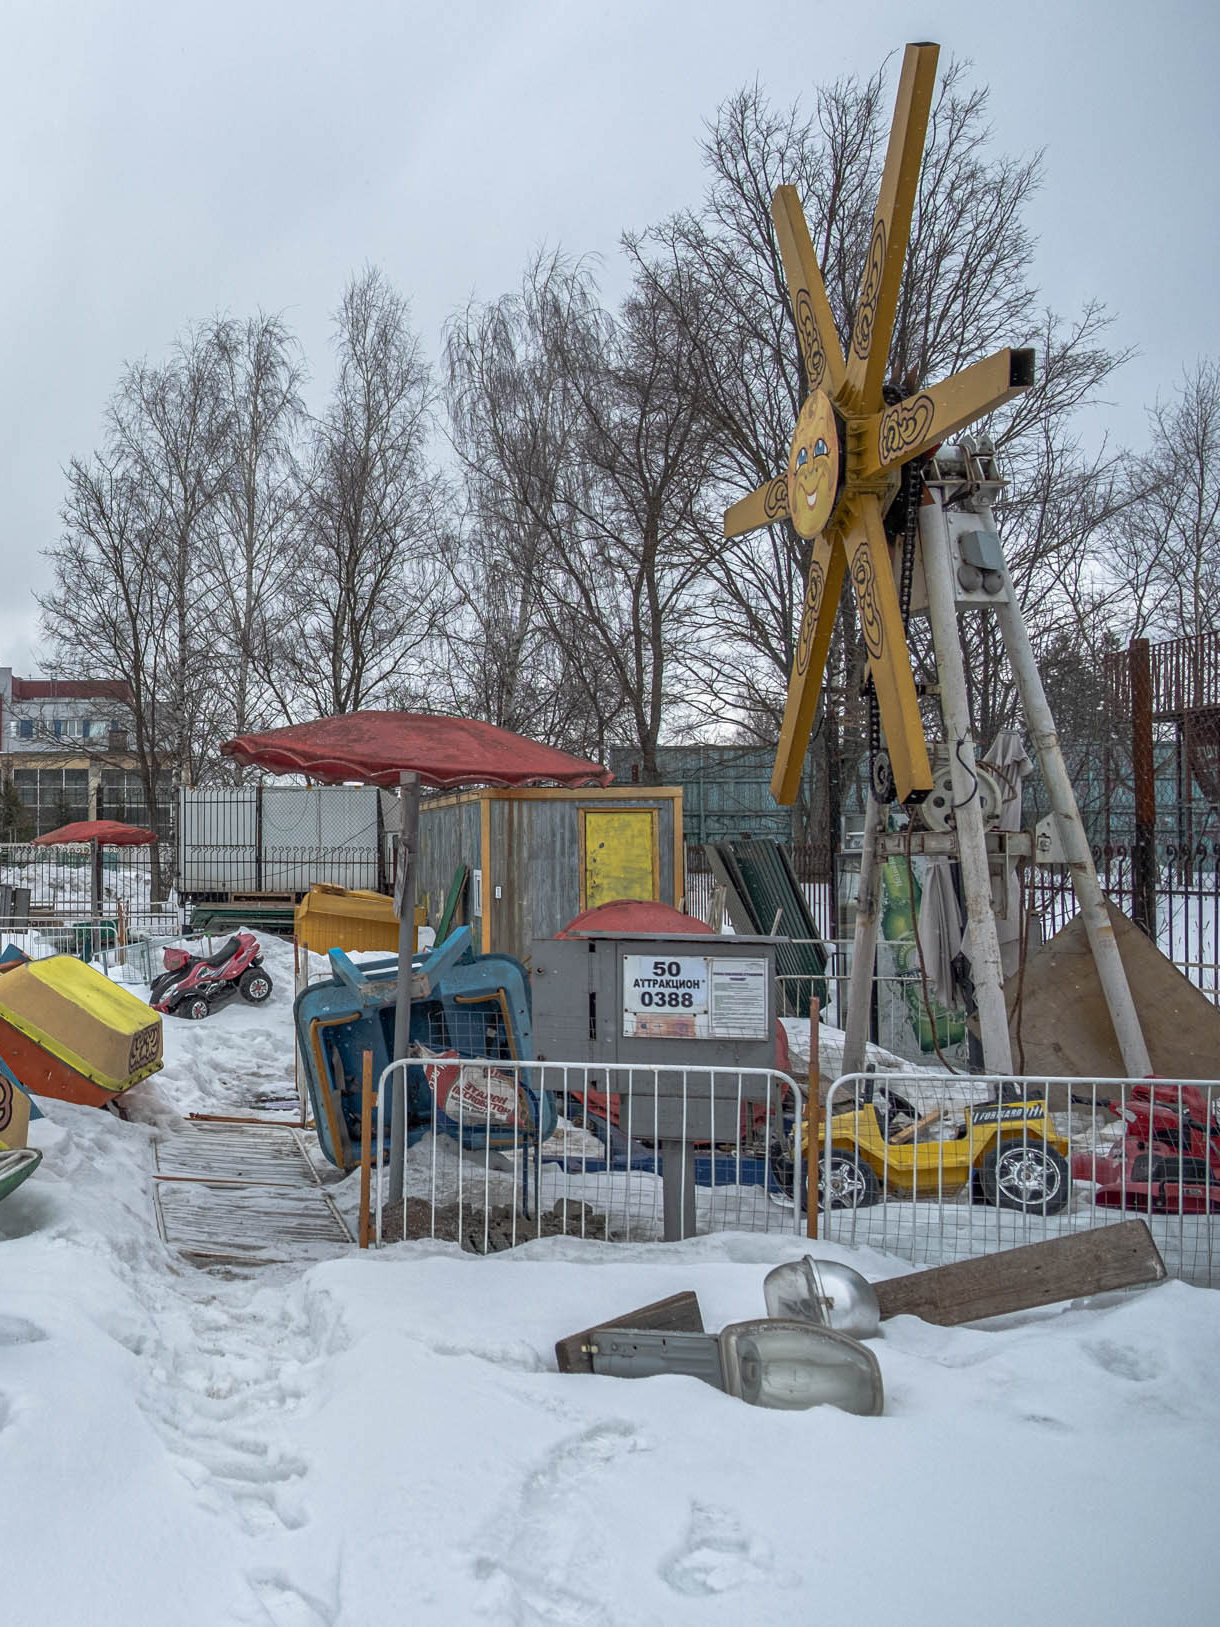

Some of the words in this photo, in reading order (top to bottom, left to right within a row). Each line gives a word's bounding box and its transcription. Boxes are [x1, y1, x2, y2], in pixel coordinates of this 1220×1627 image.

[652, 961, 681, 977] 50
[633, 978, 700, 990] АТТРАКЦИОН
[641, 992, 694, 1008] 0388
